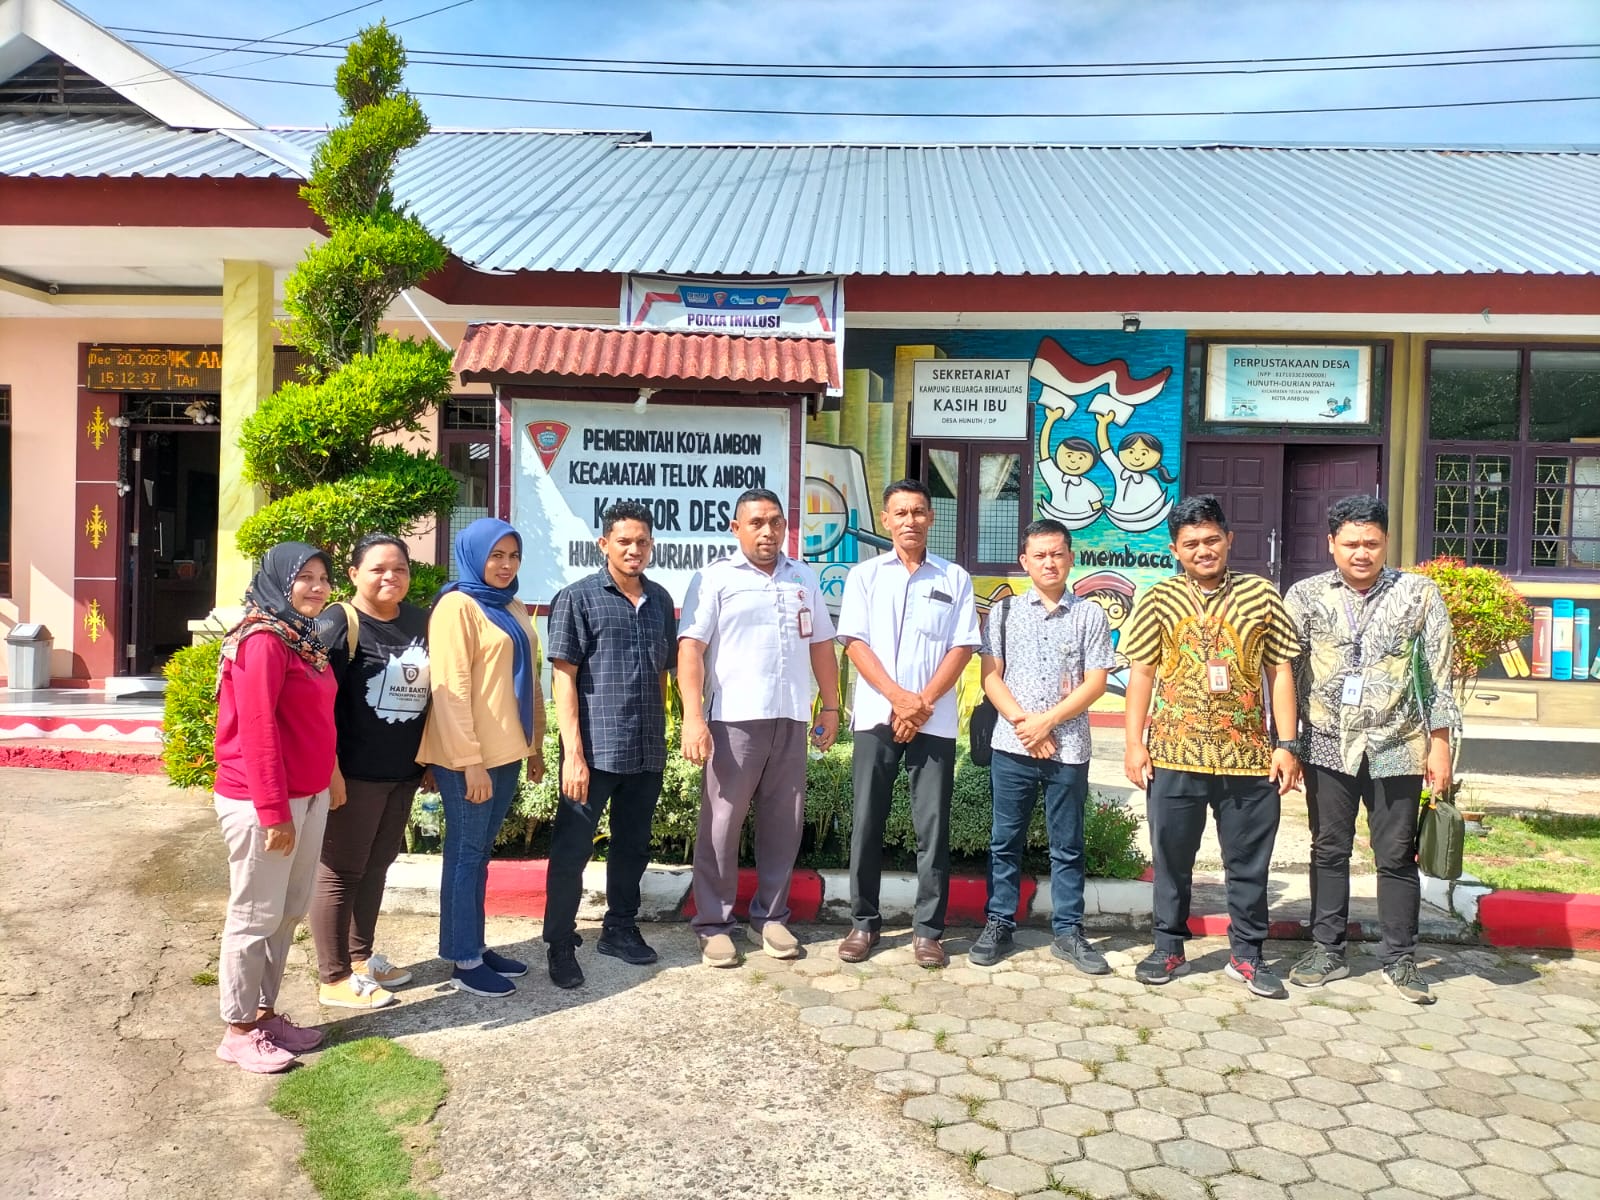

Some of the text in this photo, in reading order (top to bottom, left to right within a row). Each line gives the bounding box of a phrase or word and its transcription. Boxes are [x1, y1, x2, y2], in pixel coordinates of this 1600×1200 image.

[687, 313, 780, 328] POKJA INKLUSI
[90, 353, 111, 365] Dec
[1233, 358, 1351, 369] PERPUSTAKAAN DESA
[101, 372, 157, 384] 15:12:37
[932, 369, 1011, 380] SEKRETARIAT
[919, 385, 1023, 394] KAMPUNG KELUARGA BERKUALITAS
[933, 399, 1007, 412] KASIH IBU
[583, 428, 761, 456] PEMERINTAH KOTA AMBON
[569, 460, 766, 489] KECAMATAN TELUK AMBON
[594, 497, 732, 532] KOR DES
[569, 540, 603, 567] HUN
[1080, 544, 1173, 568] membaca
